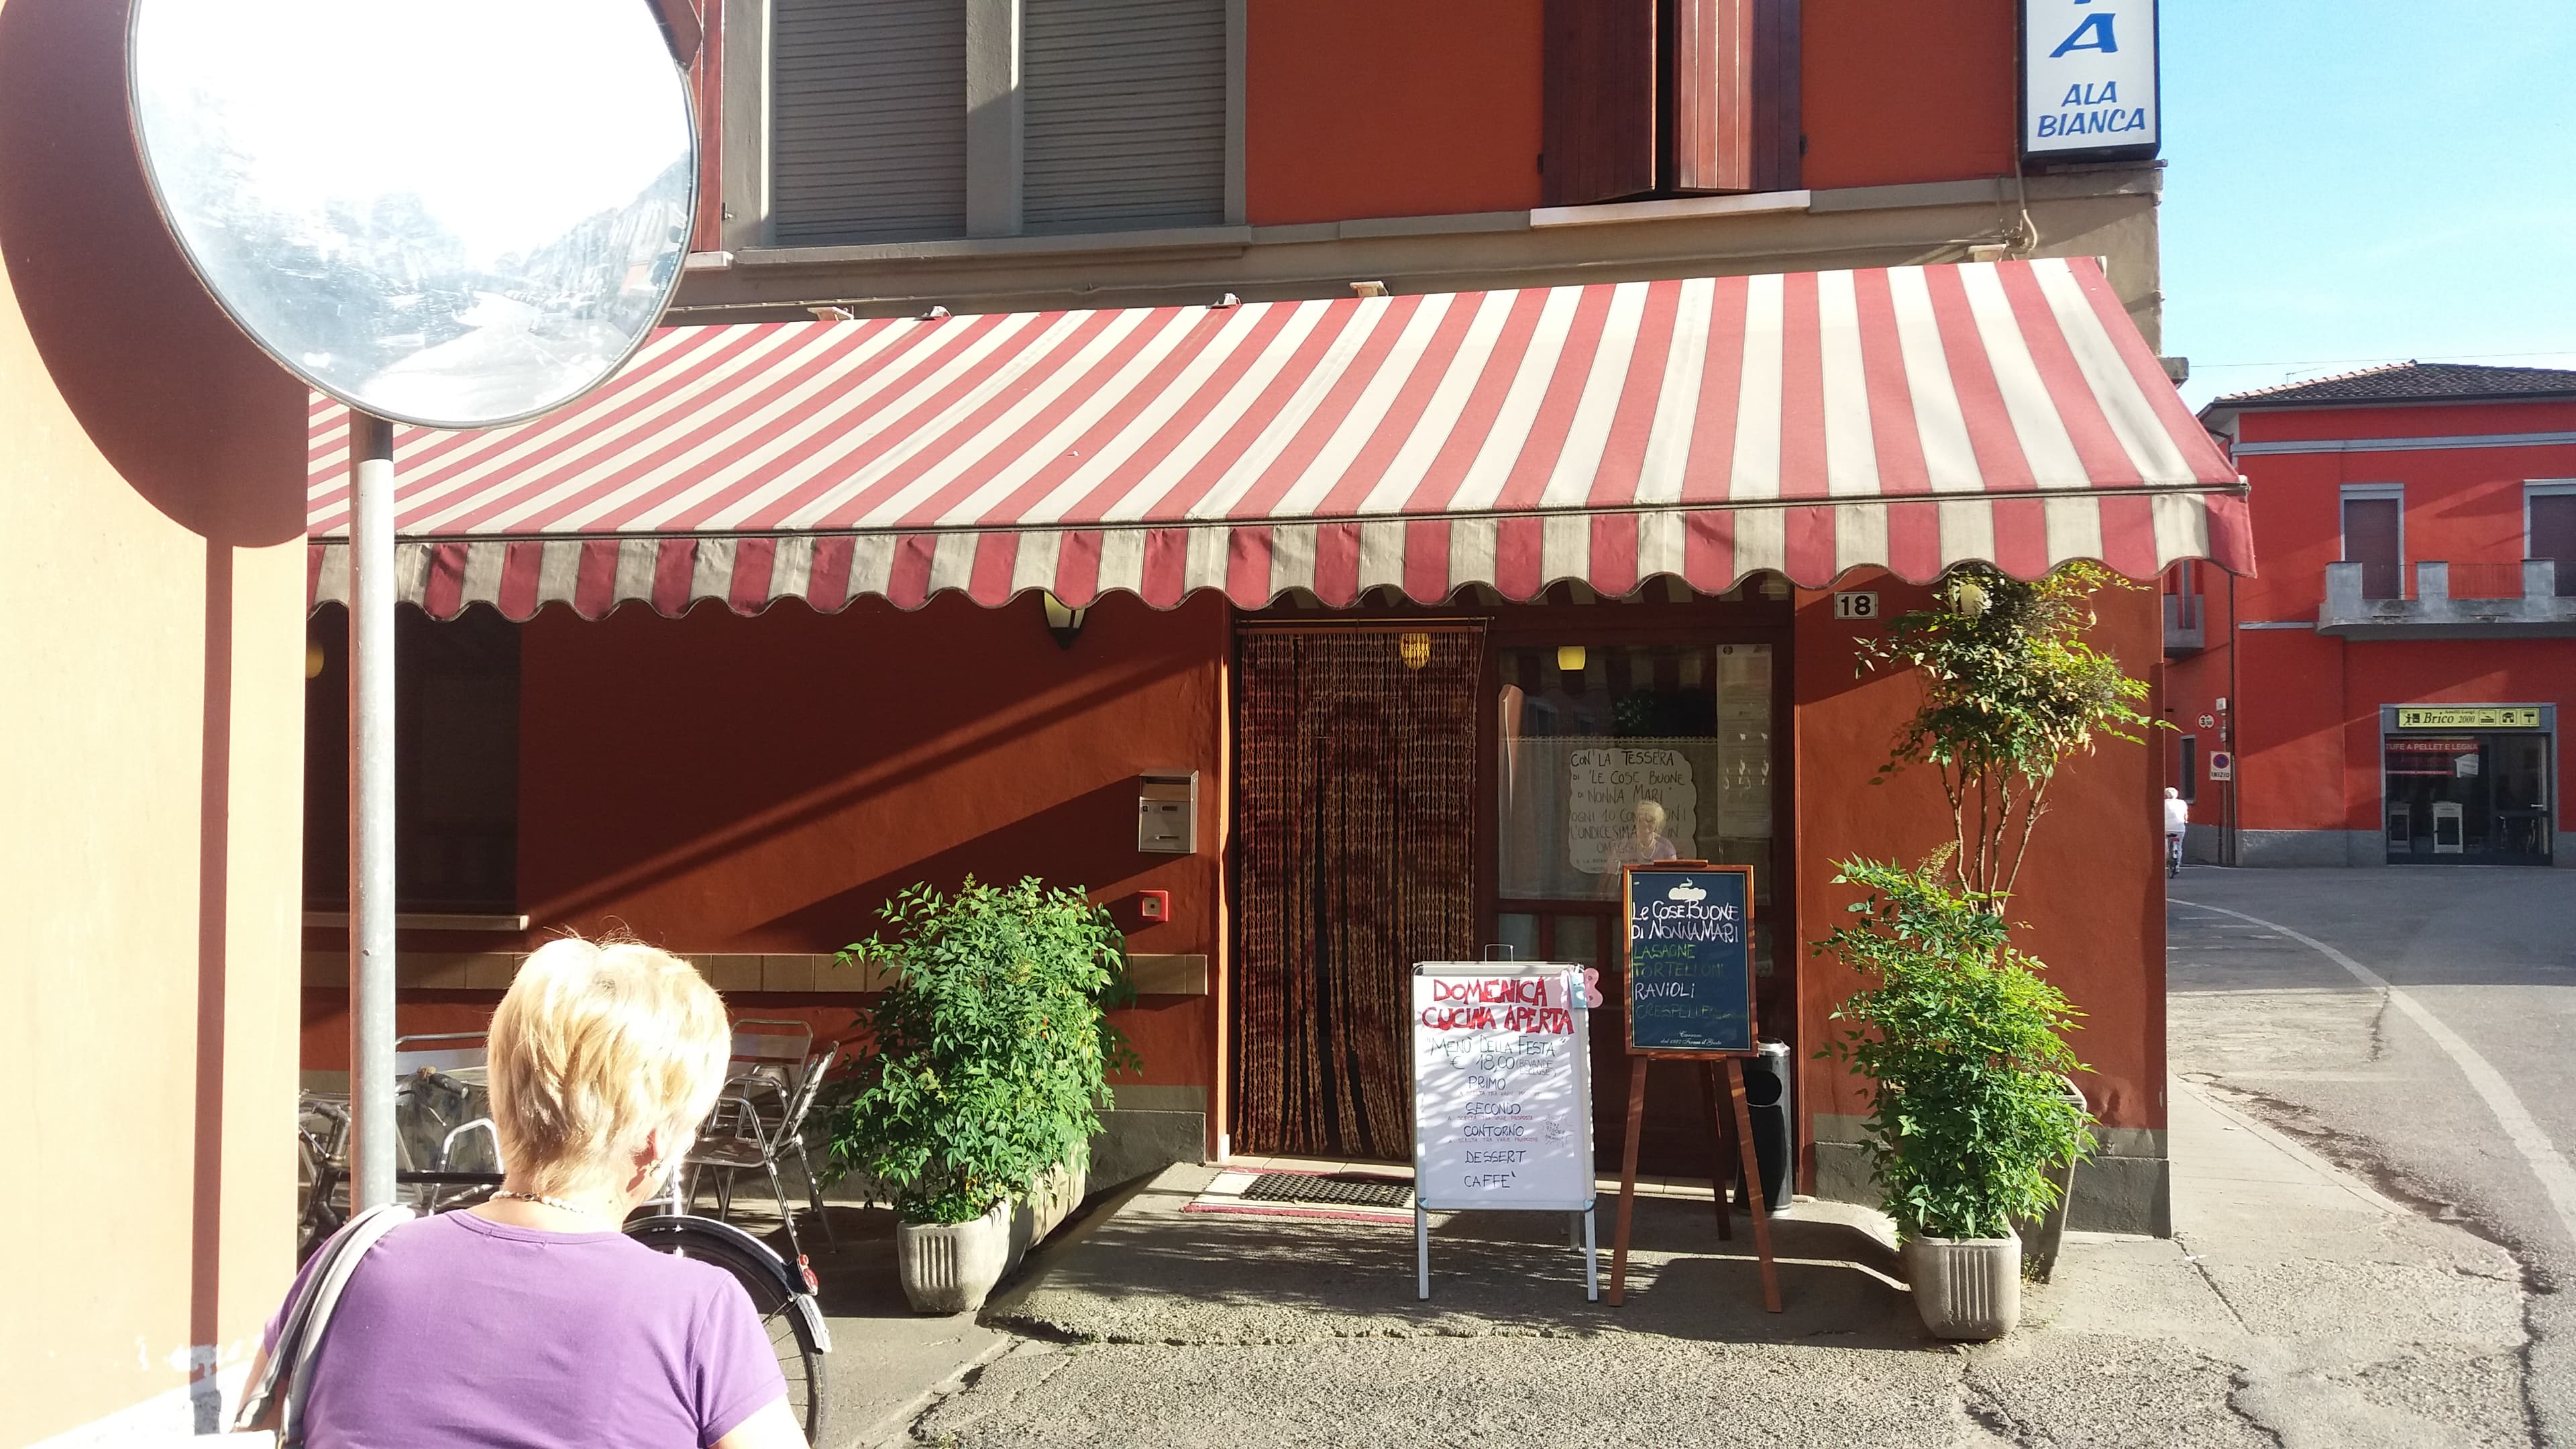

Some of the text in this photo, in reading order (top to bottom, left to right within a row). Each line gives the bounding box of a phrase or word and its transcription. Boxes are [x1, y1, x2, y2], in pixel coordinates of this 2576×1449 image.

[2049, 0, 2118, 58] A
[2061, 81, 2117, 107] ALA
[2037, 108, 2146, 138] BIANCA
[1841, 595, 1871, 616] 18
[2422, 712, 2455, 724] Brico
[2458, 715, 2475, 724] 2000
[1599, 753, 1611, 767] LA
[1621, 751, 1674, 766] TESSERA
[1649, 770, 1686, 786] BUONE
[1588, 786, 1625, 804] NONNA
[1571, 810, 1595, 822] OGNI
[1603, 808, 1616, 822] 10
[1652, 900, 1685, 920] COSE
[1685, 900, 1739, 922] BUONE
[1648, 918, 1701, 941] NONNA
[1701, 921, 1739, 943] MARI
[1633, 944, 1696, 959] LASAGNE
[1434, 976, 1547, 1006] DOMENICA
[1421, 1004, 1574, 1034] CUCINA APERTA
[1480, 1034, 1513, 1055] DELLA
[1450, 1055, 1466, 1070] €
[1476, 1054, 1515, 1073] 18,00
[1468, 1075, 1506, 1091] PRIMO
[1465, 1102, 1521, 1116] SECONDO
[1464, 1123, 1525, 1138] CONTORNO
[1464, 1150, 1527, 1164] DESSERT
